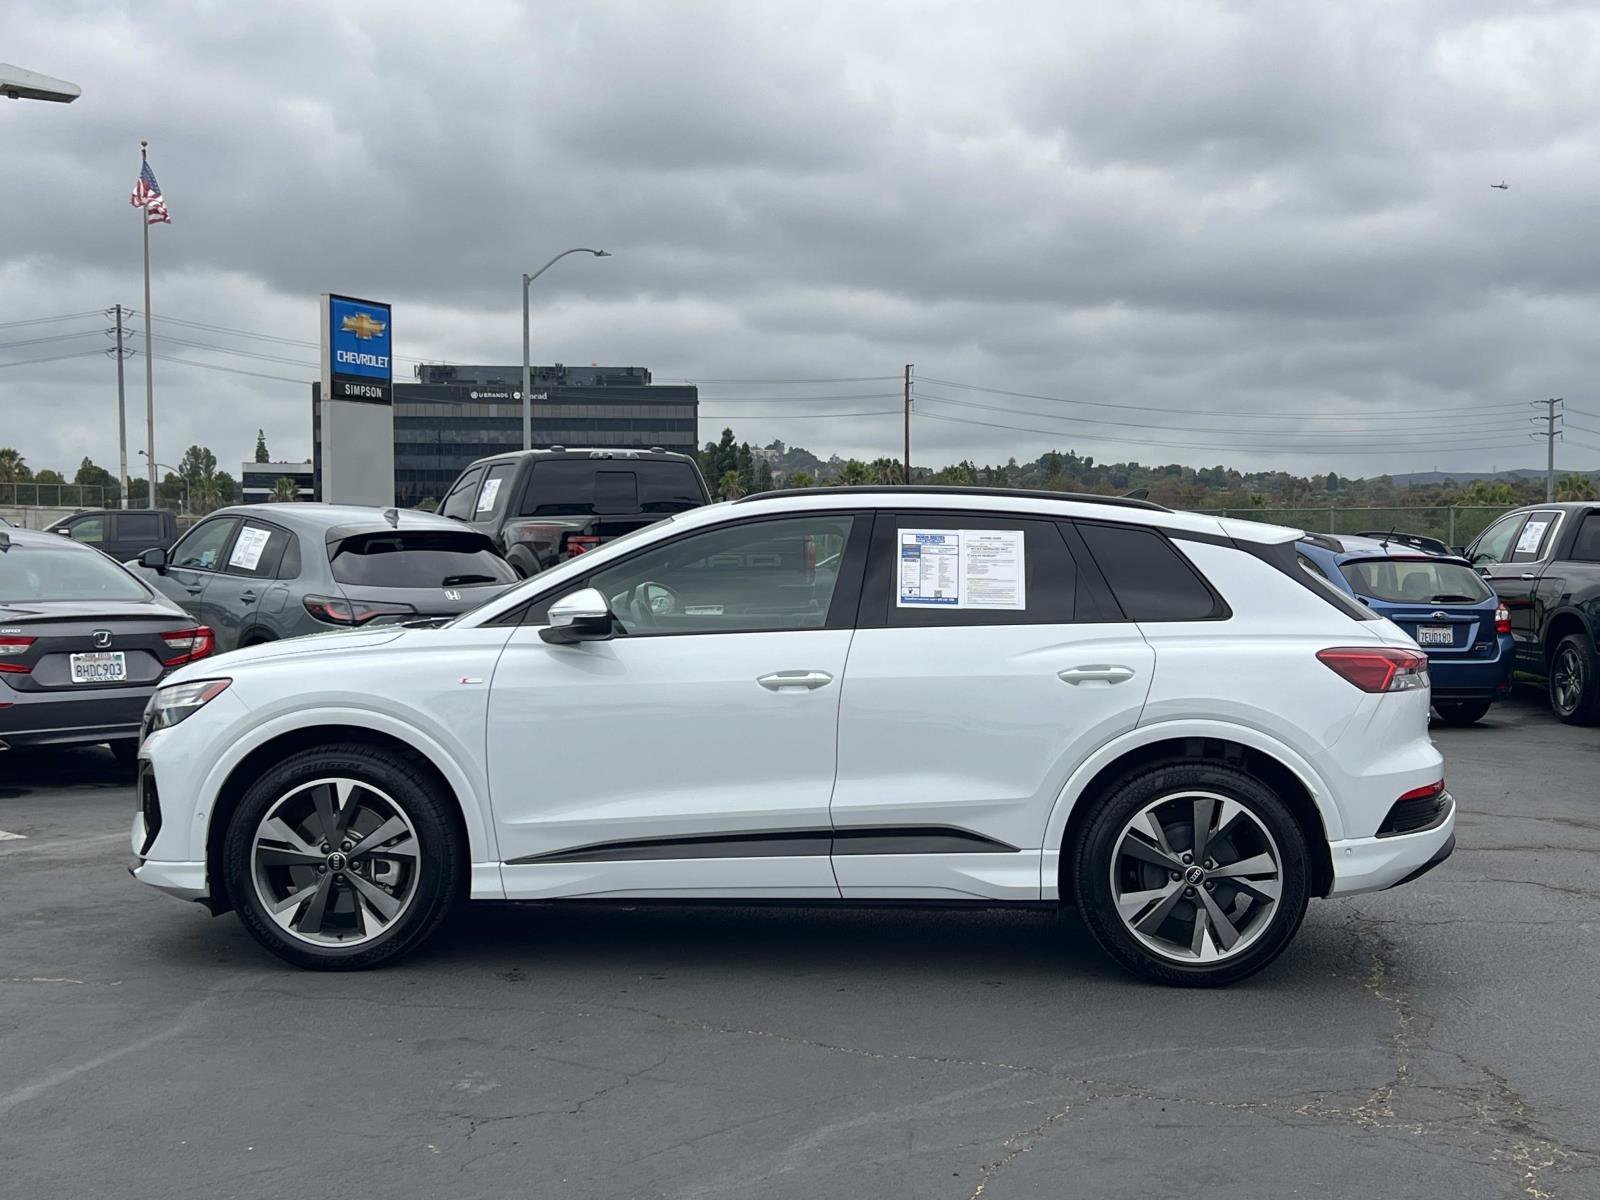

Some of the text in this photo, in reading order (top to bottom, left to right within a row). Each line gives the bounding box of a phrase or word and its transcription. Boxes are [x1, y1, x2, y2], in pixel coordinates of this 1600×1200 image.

[337, 350, 389, 368] CHEVROLET
[345, 384, 382, 398] SIMPSON
[76, 662, 122, 678] 8HDC903
